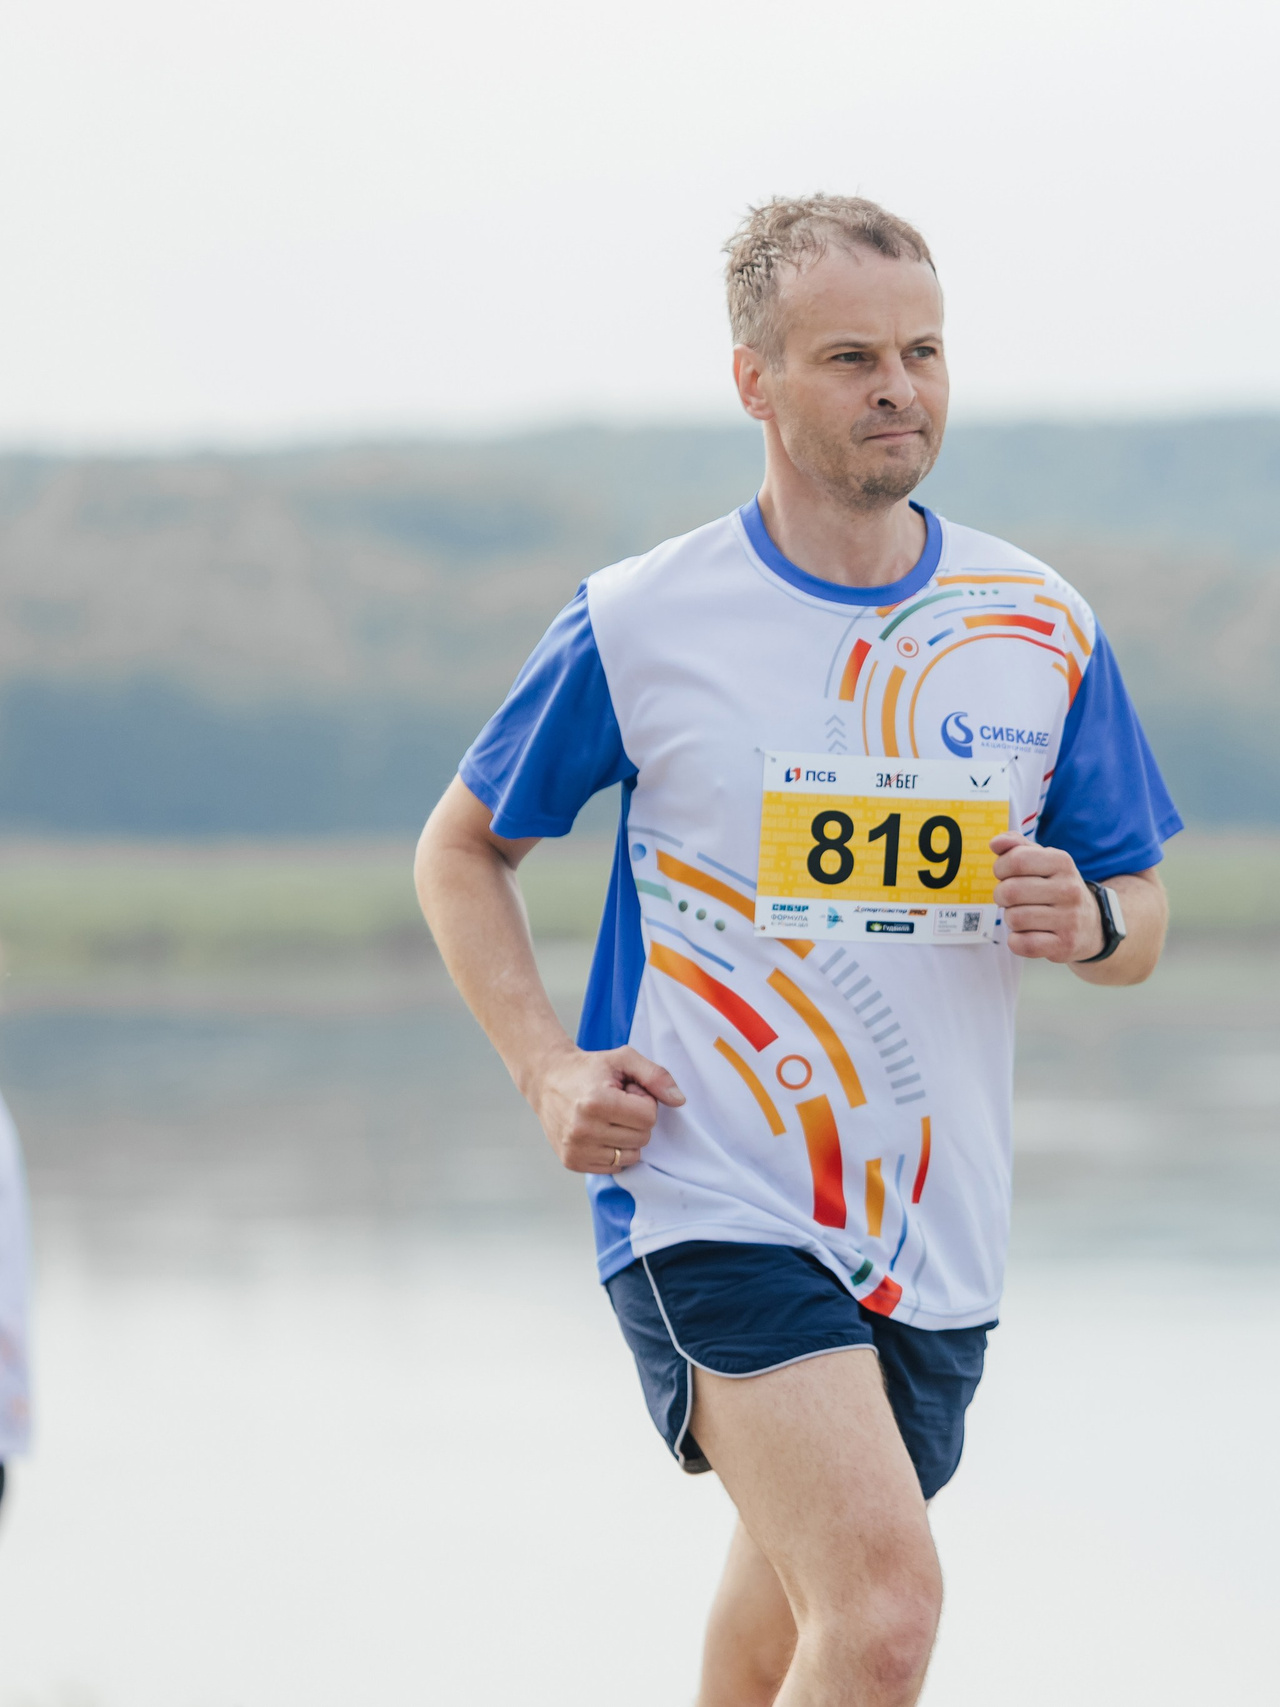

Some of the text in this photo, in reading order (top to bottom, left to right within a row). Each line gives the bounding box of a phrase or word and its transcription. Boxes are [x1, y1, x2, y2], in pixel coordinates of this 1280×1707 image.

[980, 725, 1050, 747] СИБКАБЕ
[805, 770, 836, 783] ПСБ
[807, 809, 963, 890] 819
[772, 903, 809, 912] СИБУР
[771, 914, 808, 922] ФОРМУЛА
